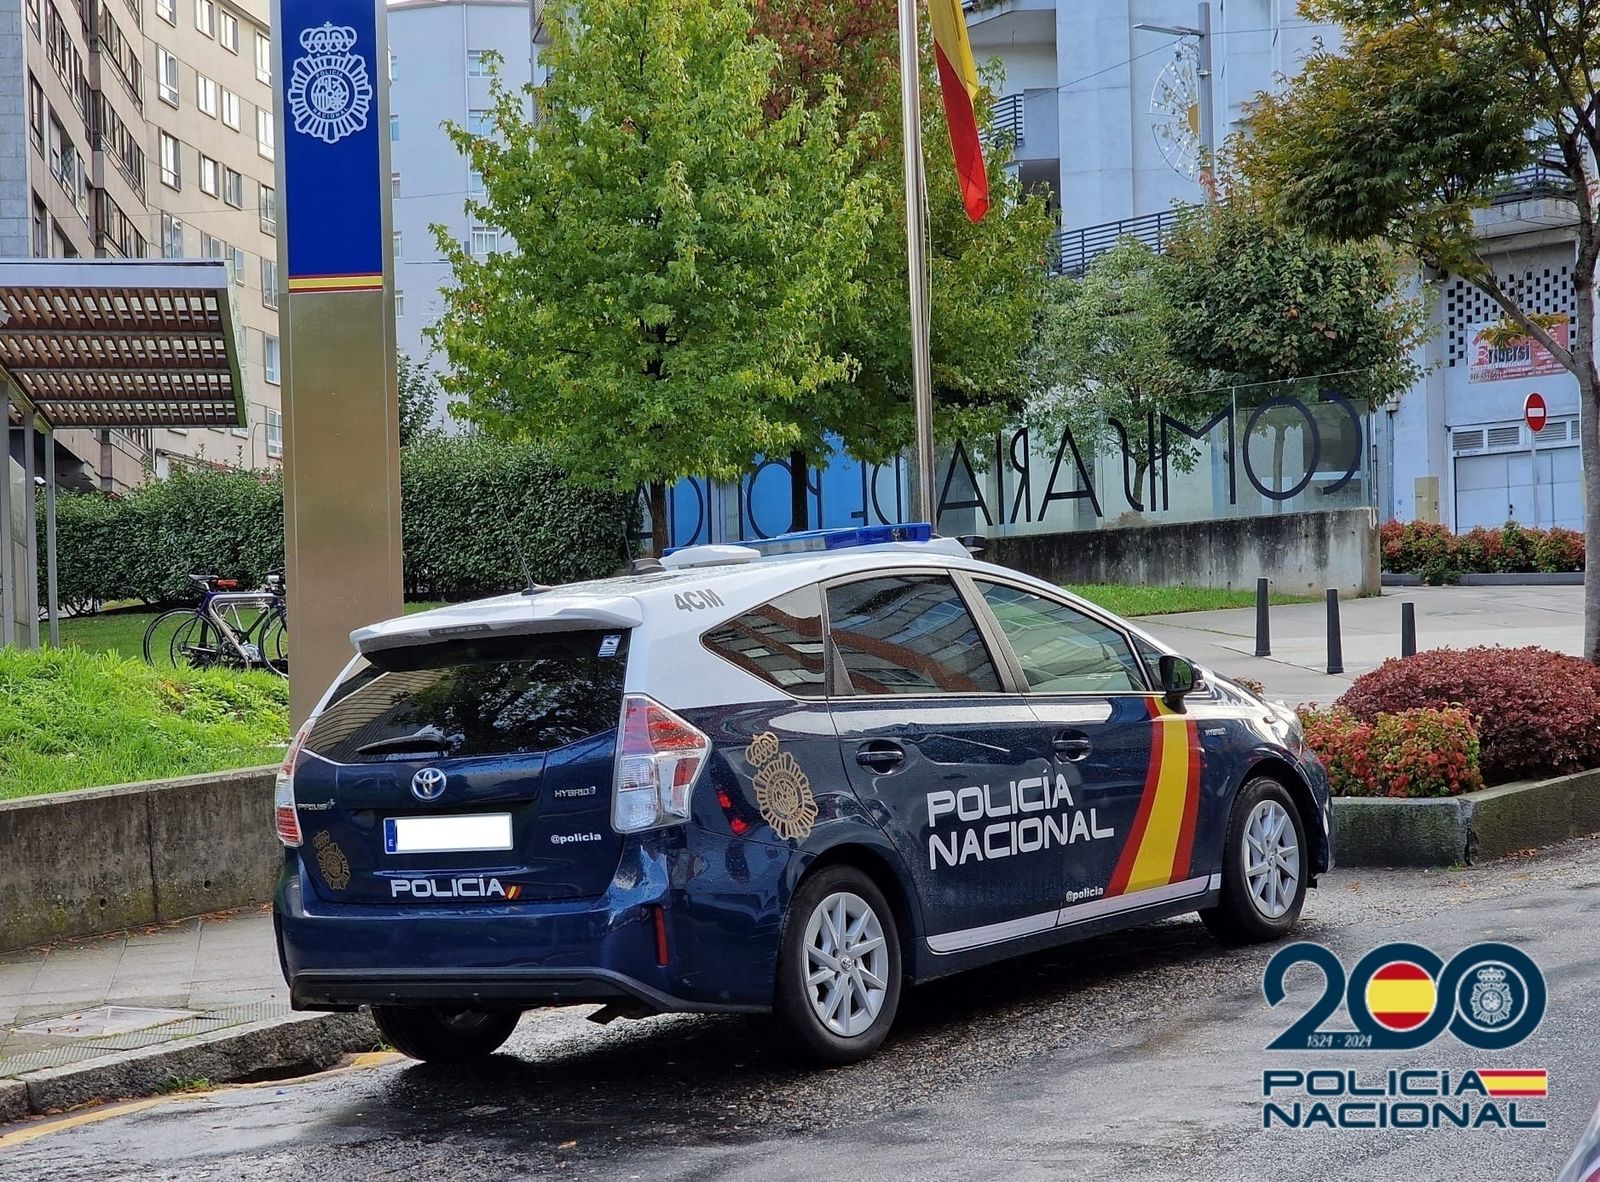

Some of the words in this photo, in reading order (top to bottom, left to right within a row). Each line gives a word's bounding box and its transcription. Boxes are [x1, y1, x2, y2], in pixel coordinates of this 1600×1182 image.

[673, 588, 726, 613] 4CM
[554, 787, 590, 798] HYBRID
[388, 839, 394, 847] E
[550, 832, 602, 845] @policia
[928, 808, 1115, 870] NACIONAL
[1065, 886, 1104, 903] @policia
